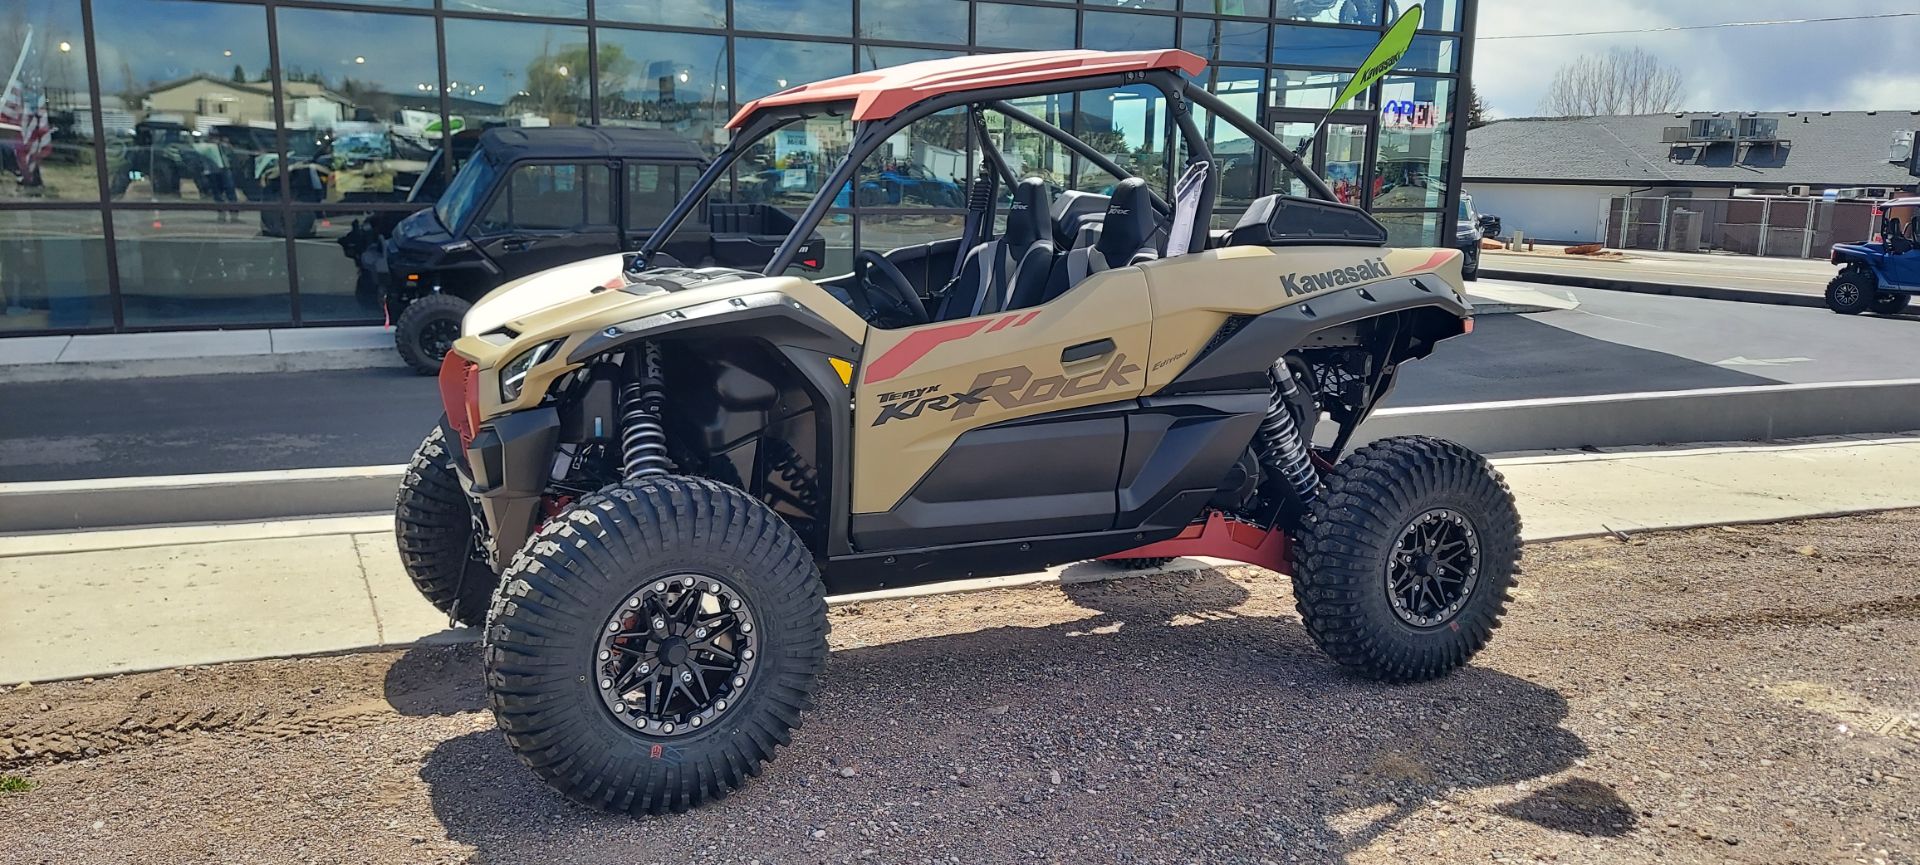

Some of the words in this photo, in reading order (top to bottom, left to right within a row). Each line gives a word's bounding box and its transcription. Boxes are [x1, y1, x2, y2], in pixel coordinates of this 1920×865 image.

[1384, 100, 1440, 128] OPEN
[1279, 256, 1392, 298] Kawasaki
[870, 385, 993, 427] KRX
[950, 352, 1141, 422] Rock
